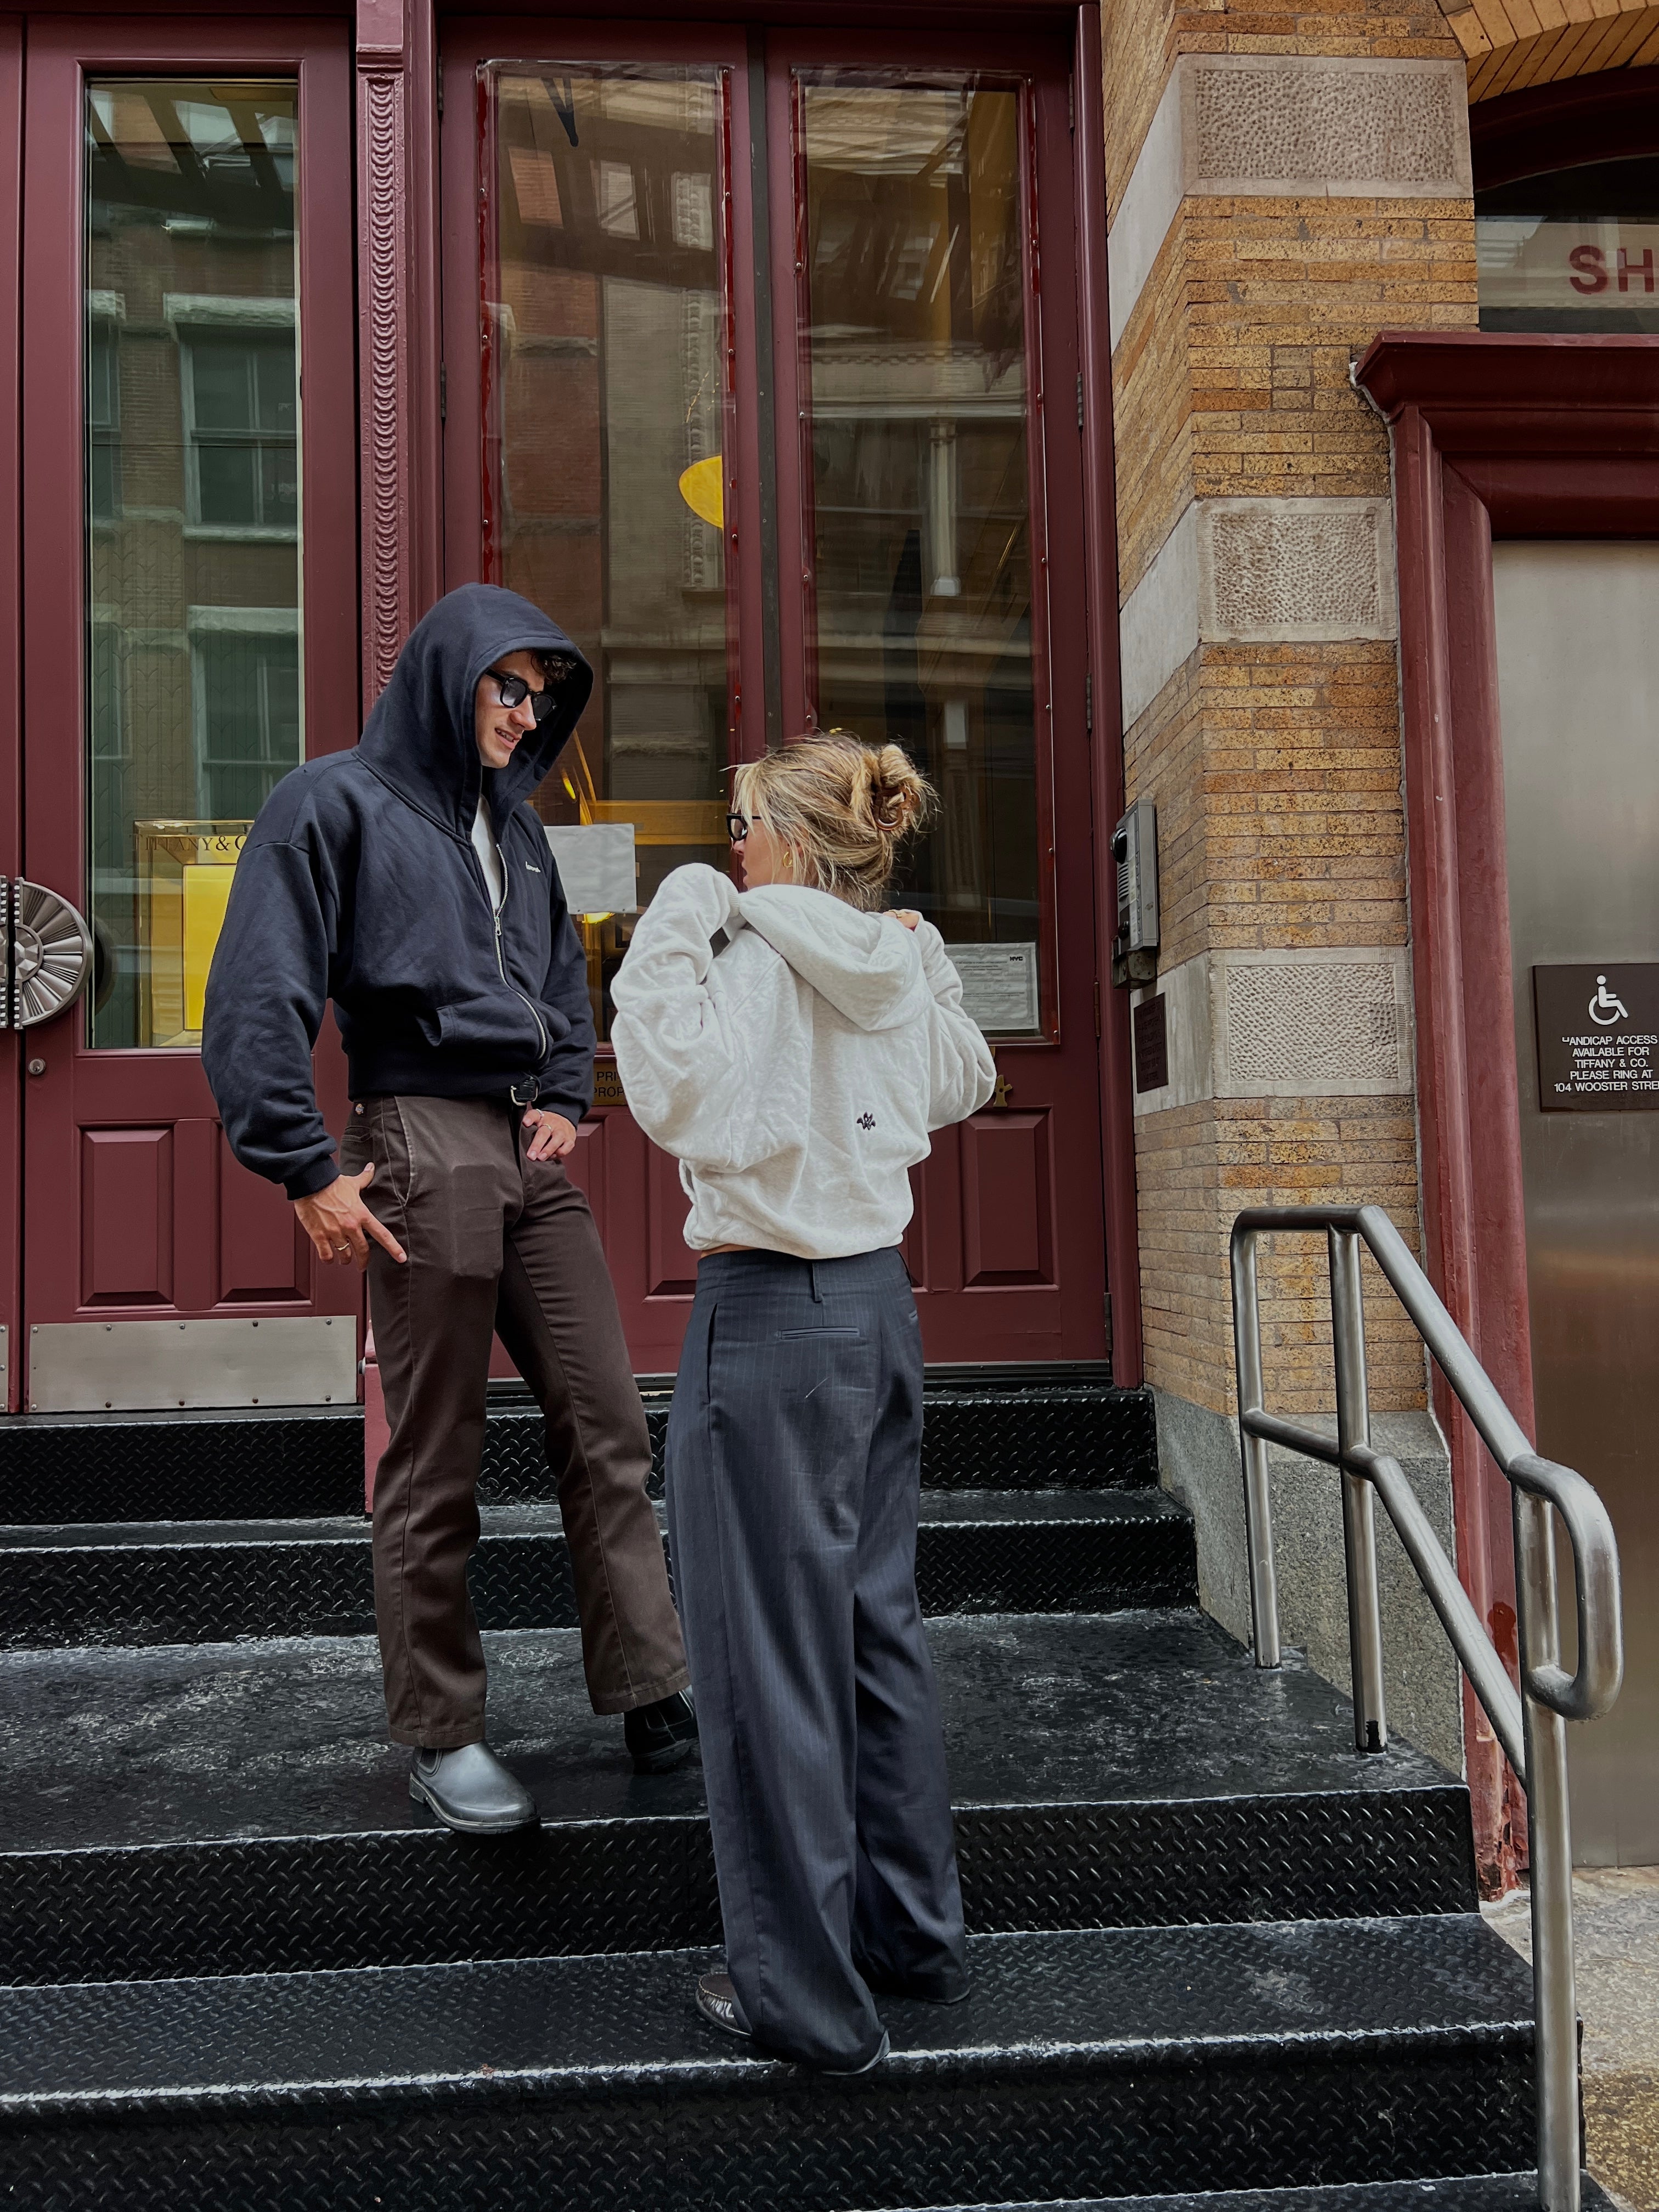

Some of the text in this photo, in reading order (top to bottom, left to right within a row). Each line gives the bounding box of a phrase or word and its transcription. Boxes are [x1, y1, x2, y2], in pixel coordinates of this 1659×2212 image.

[216, 836, 230, 850] &
[1616, 1035, 1658, 1045] ACCESS
[1572, 1046, 1650, 1057] AVAILABLE FOR
[1575, 1058, 1648, 1069] TIFFANY & CO.
[596, 1071, 618, 1081] PRI
[1570, 1069, 1654, 1080] PLEASE RING AT
[1554, 1081, 1659, 1092] 104 WOOSTER STRE
